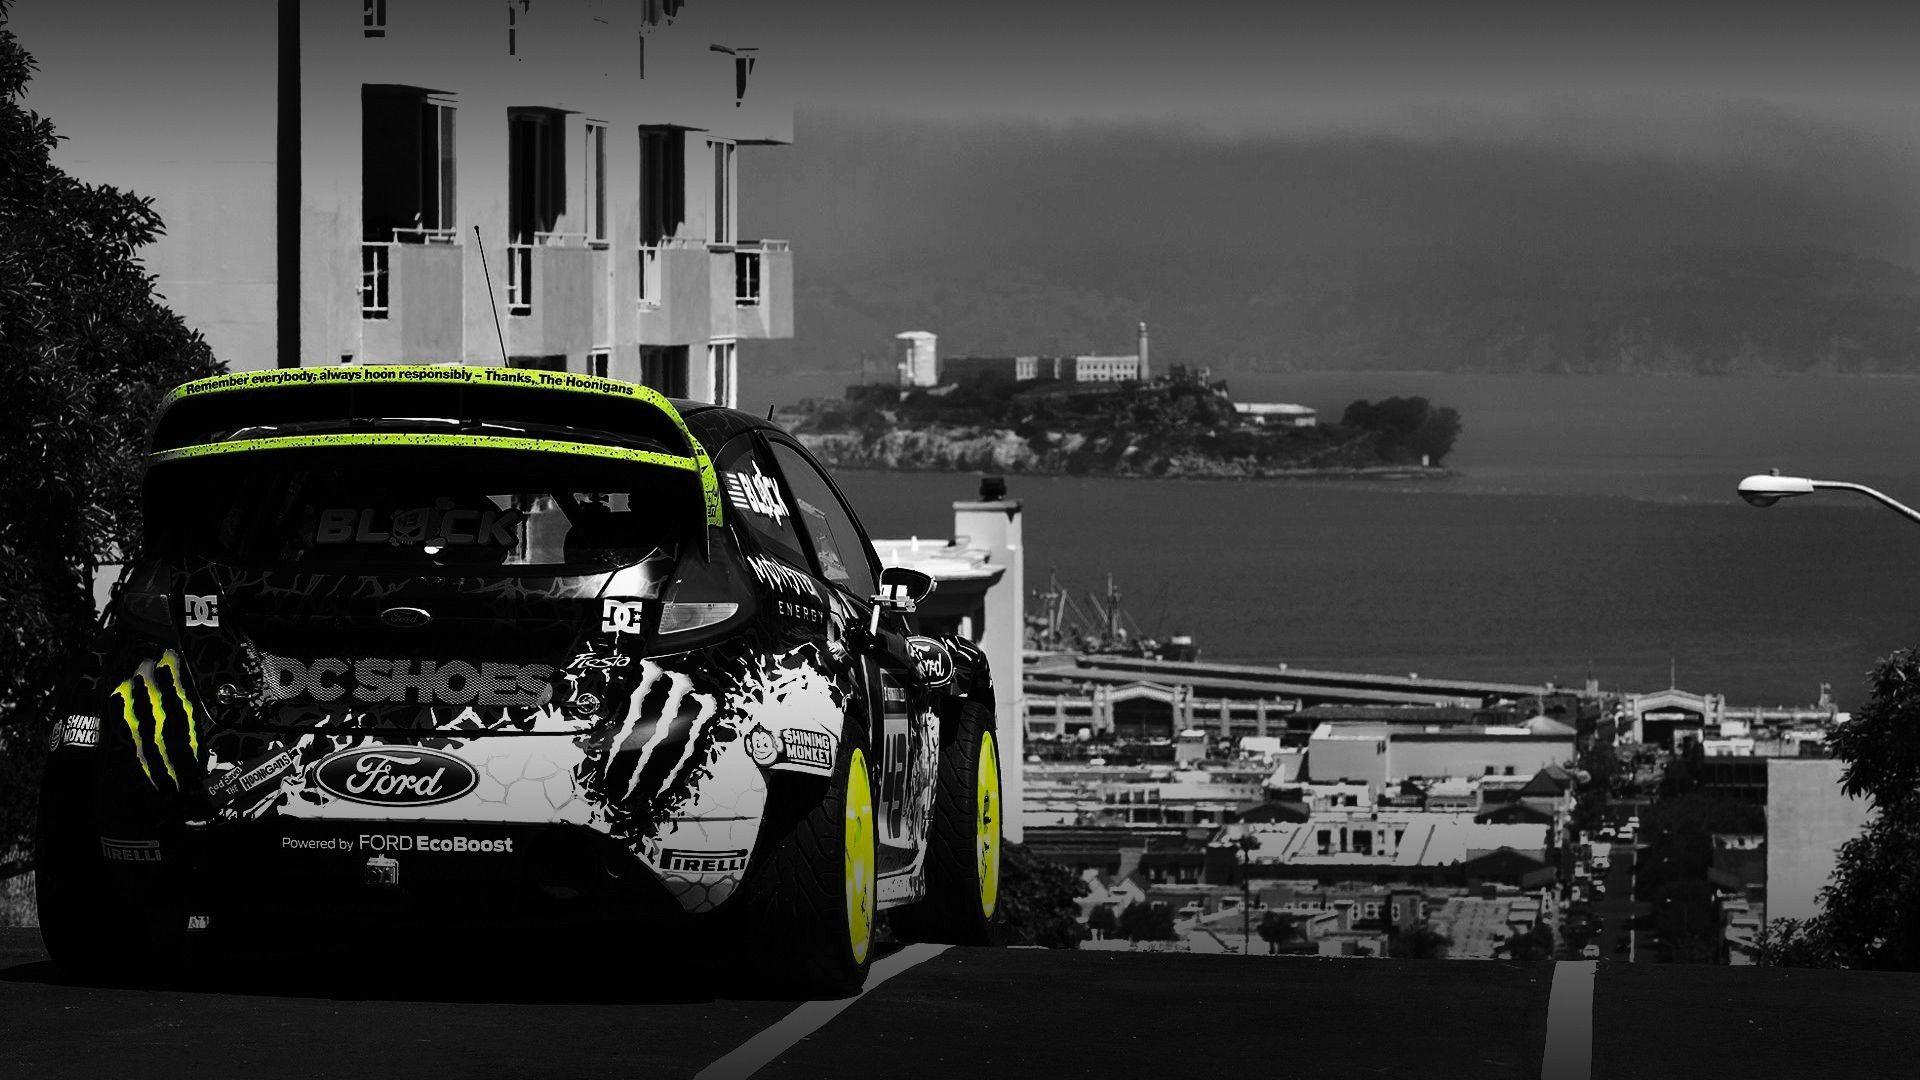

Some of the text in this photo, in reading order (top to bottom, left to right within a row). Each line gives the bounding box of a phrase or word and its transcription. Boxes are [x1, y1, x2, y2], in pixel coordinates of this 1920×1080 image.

[186, 375, 250, 394] Remember
[319, 369, 362, 382] always
[364, 368, 396, 380] hoon
[398, 369, 472, 381] responsibly
[485, 370, 534, 385] Thanks,
[539, 373, 562, 386] The
[565, 375, 634, 396] Hoonigans
[778, 600, 824, 624] ENERGY
[261, 652, 553, 706] DC SHOES
[782, 728, 830, 750] SHINING
[785, 744, 831, 764] MONKEY
[242, 754, 291, 790] HOONIGANS
[282, 834, 514, 852] Powered by FORD EcoBoost
[659, 848, 748, 872] PIRELLI
